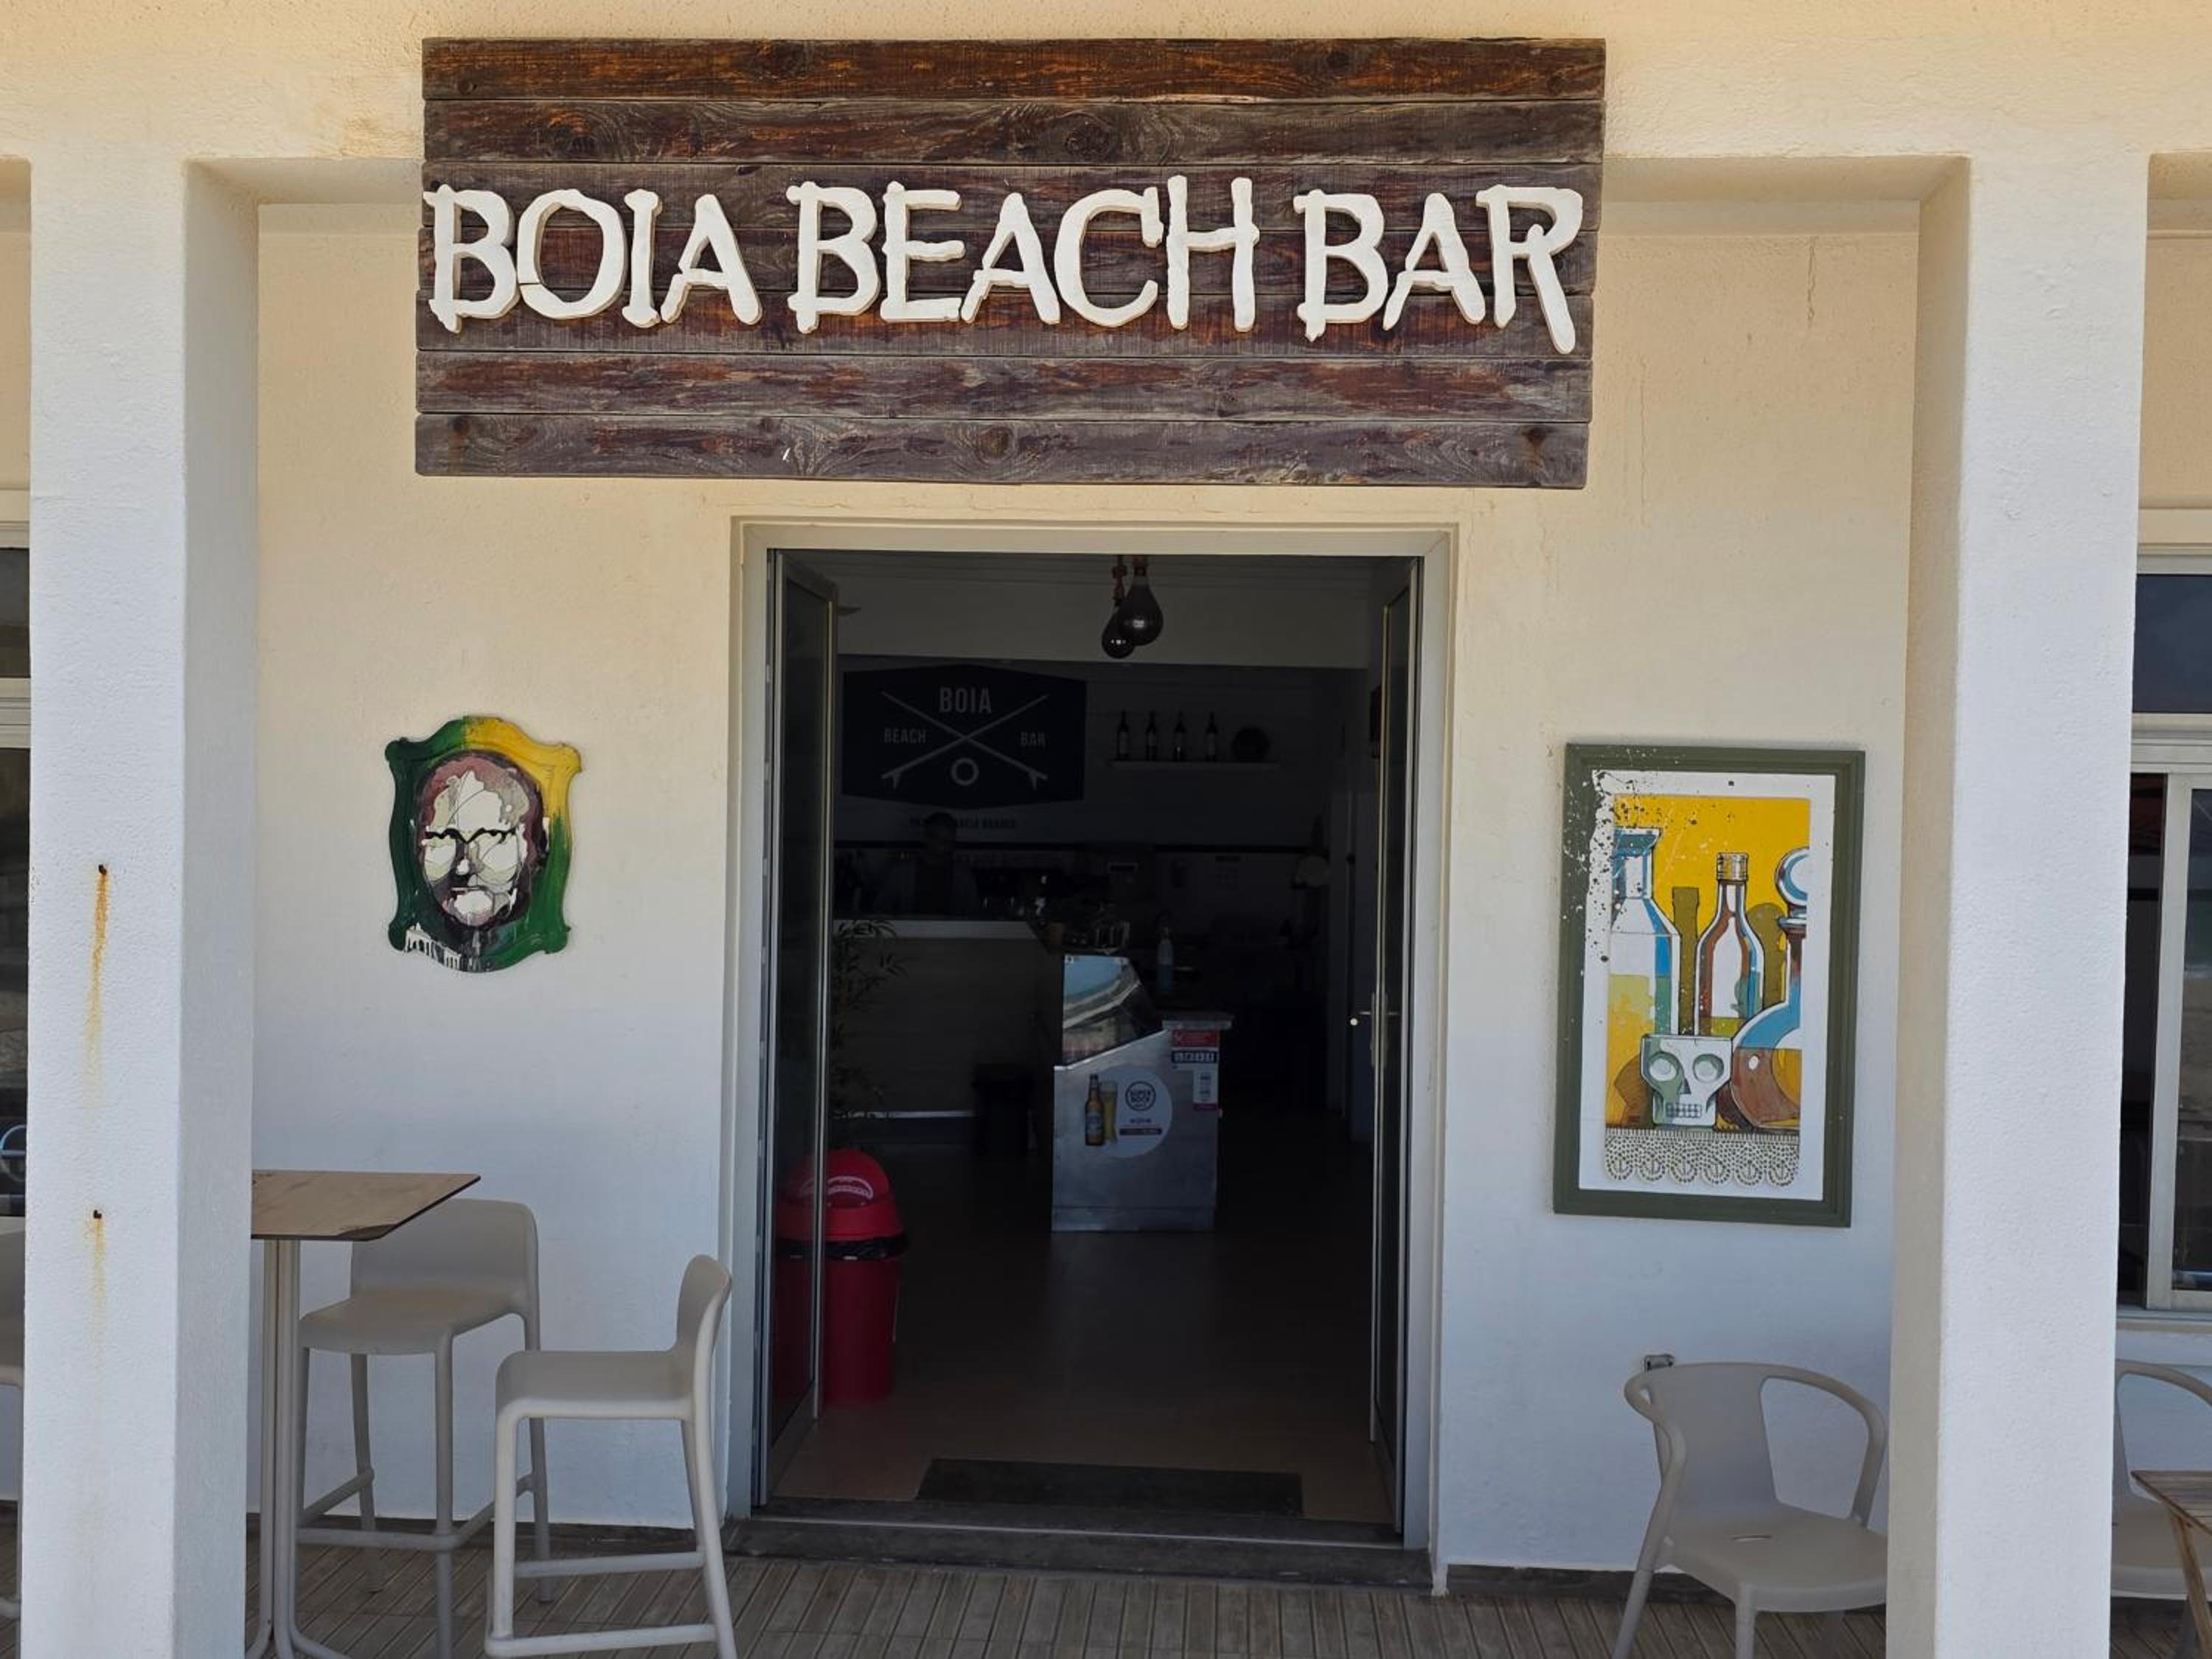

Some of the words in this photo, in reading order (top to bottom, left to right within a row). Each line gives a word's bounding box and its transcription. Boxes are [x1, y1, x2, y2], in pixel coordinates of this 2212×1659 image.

[423, 183, 762, 333] BOIA
[786, 175, 1260, 333] BEACH
[1293, 184, 1584, 355] BAR
[939, 686, 992, 714] BOIA
[883, 727, 928, 744] BEACH
[1020, 731, 1047, 747] BAR
